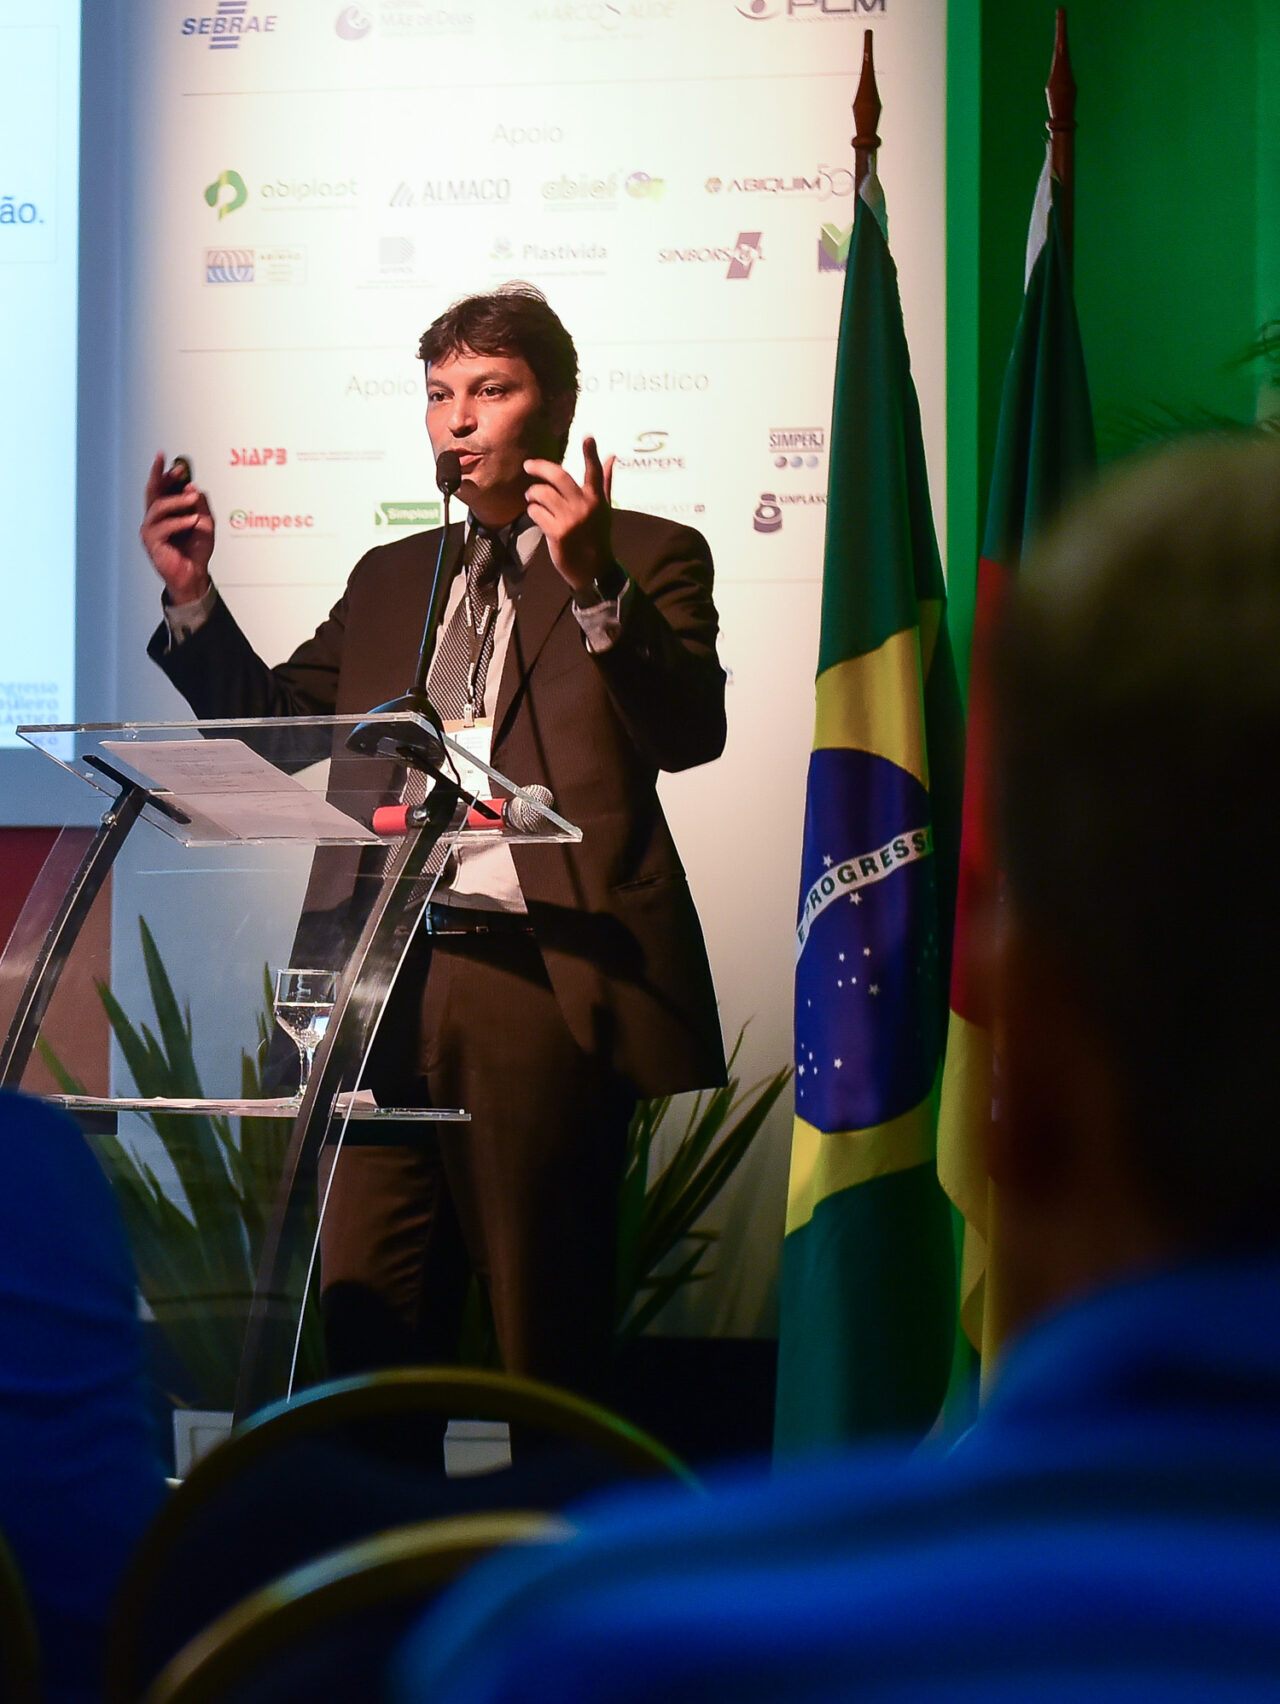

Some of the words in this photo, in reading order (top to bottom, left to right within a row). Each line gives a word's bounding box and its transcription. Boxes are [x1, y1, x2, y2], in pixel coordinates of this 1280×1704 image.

[181, 15, 277, 34] SEBRAE
[492, 121, 564, 147] Apoio
[261, 178, 359, 202] abiplast
[422, 179, 511, 202] ALMACO
[522, 243, 607, 260] Plastivida
[345, 374, 418, 399] Apoio
[609, 369, 709, 392] Plástico
[769, 433, 824, 448] SIMPERJ
